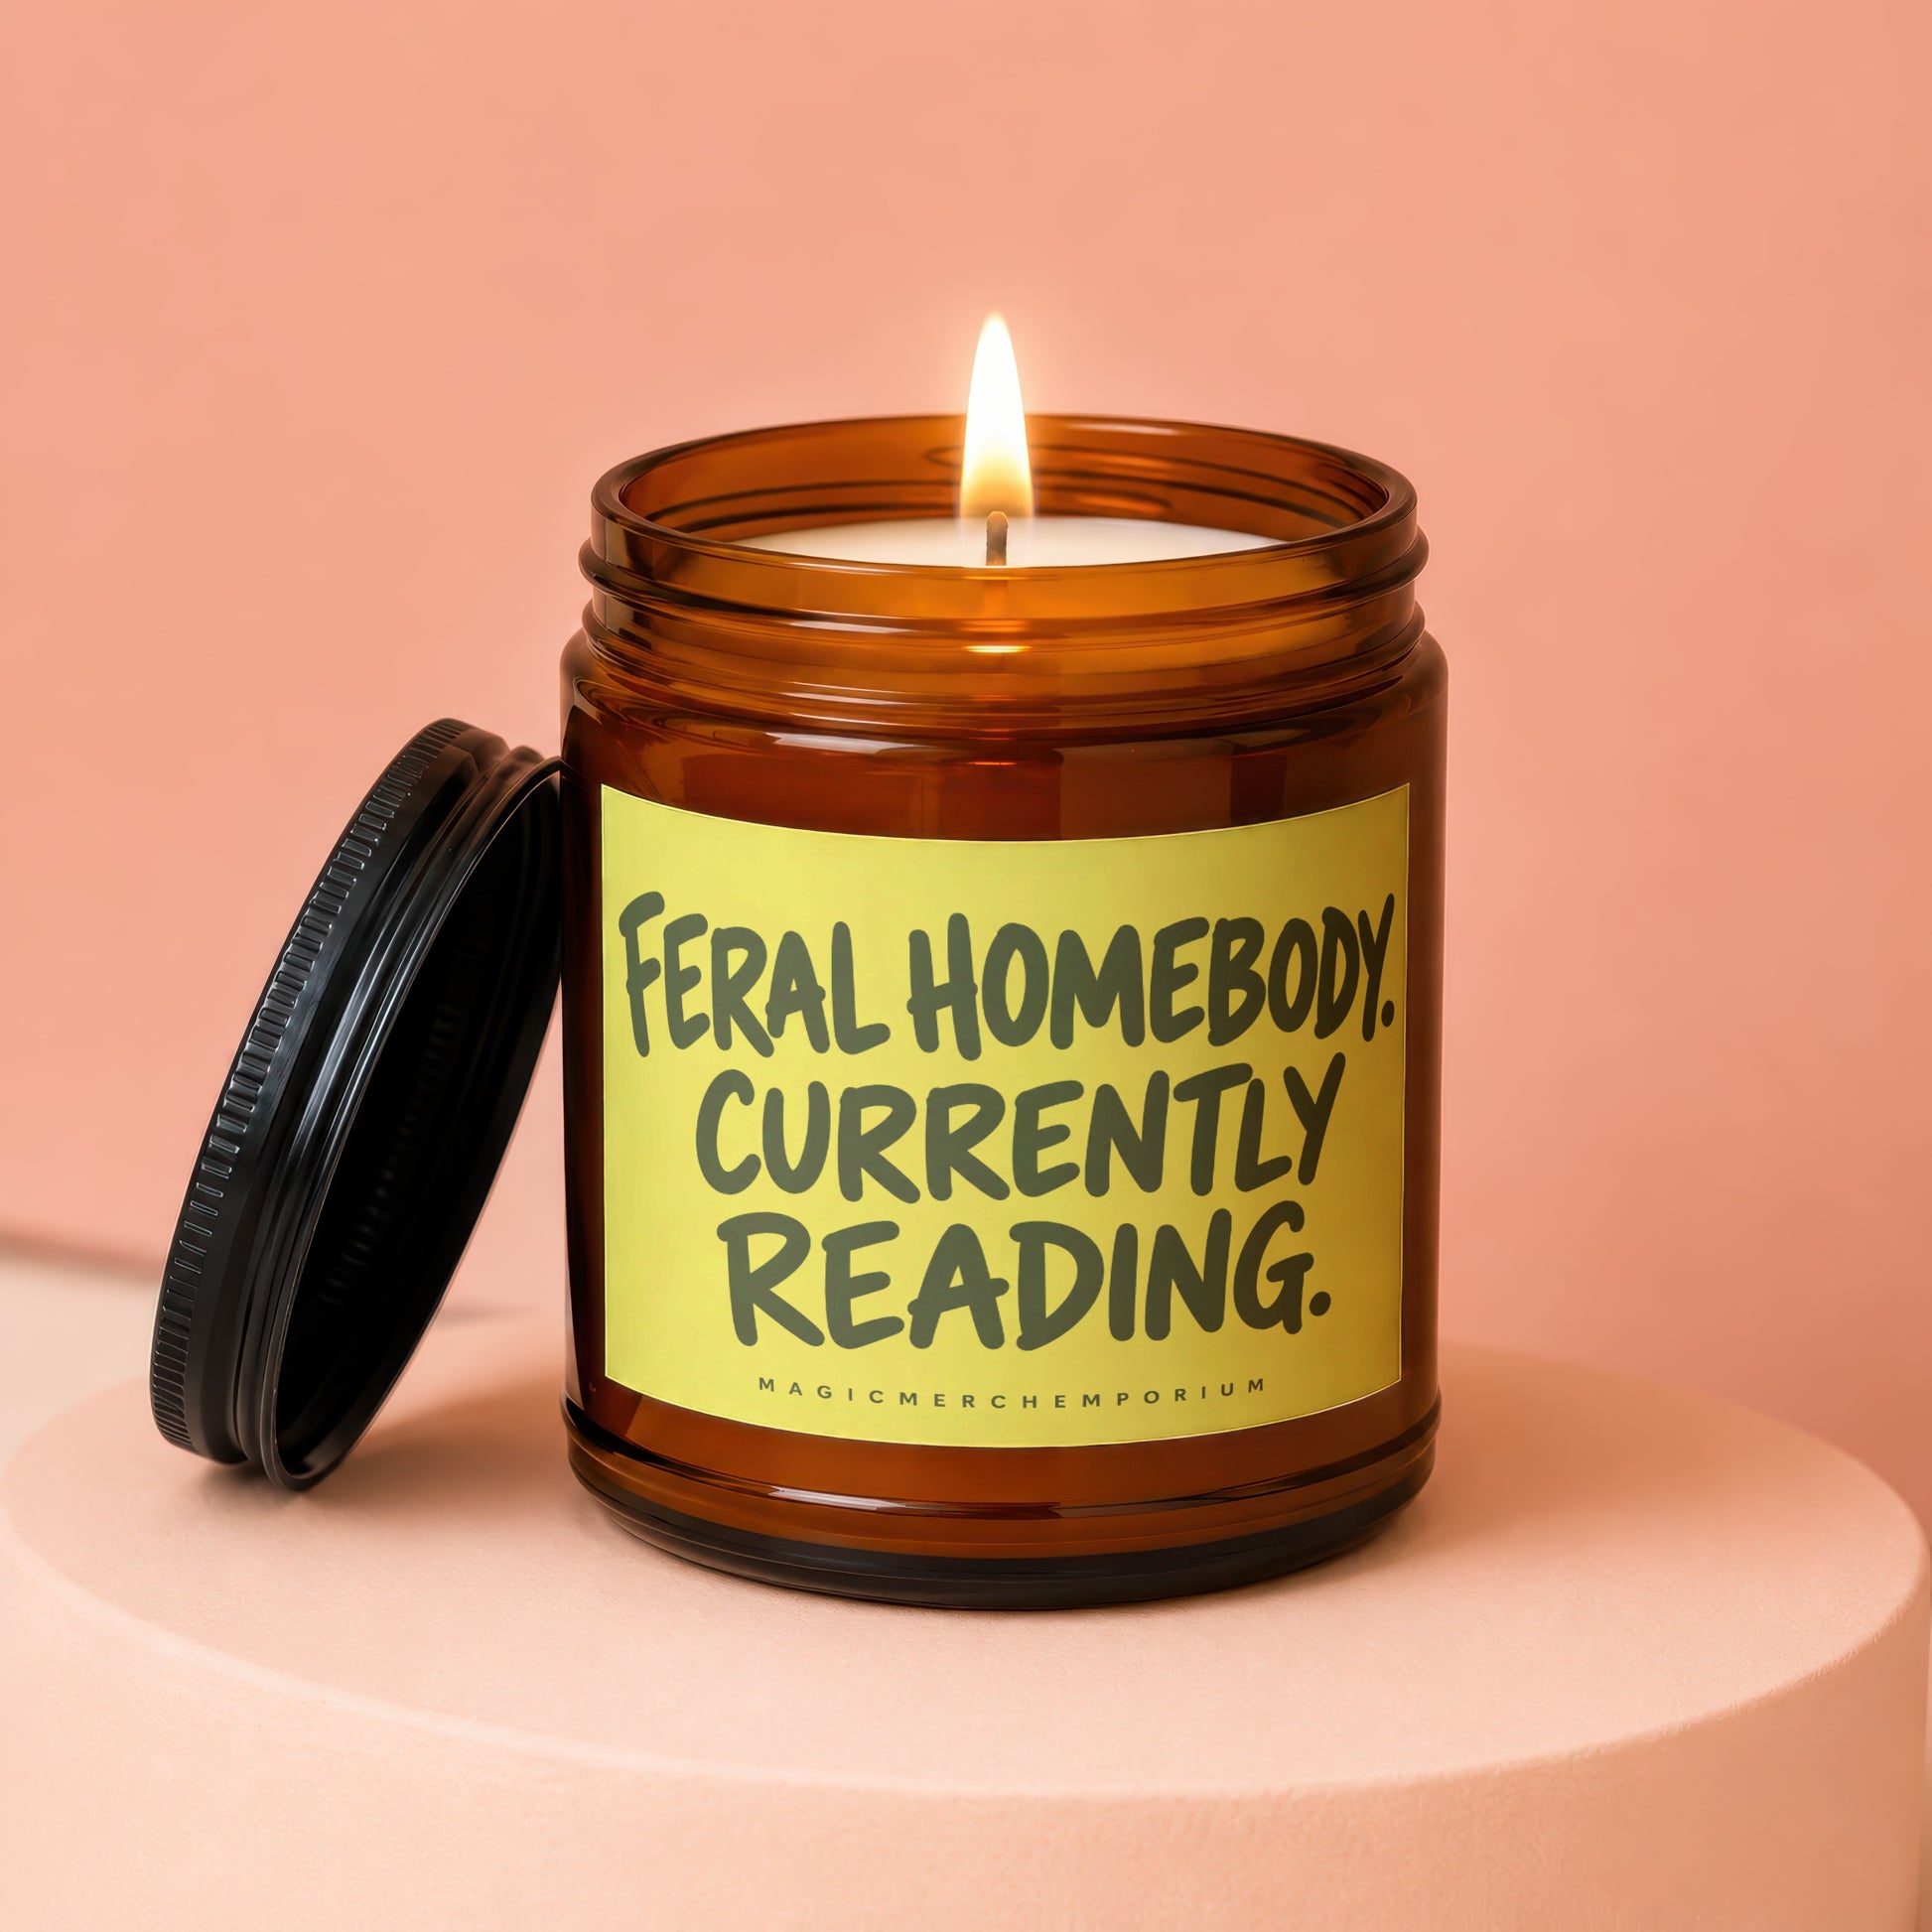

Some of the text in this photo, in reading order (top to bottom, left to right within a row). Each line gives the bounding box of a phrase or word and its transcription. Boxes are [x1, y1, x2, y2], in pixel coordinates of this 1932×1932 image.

[618, 891, 1398, 1060] FERAL HOMEBODY.
[695, 1051, 1347, 1203] CURRENTLY
[716, 1200, 1332, 1351] READING.
[758, 1376, 1265, 1410] MAGICMERCHEMPORIUM
